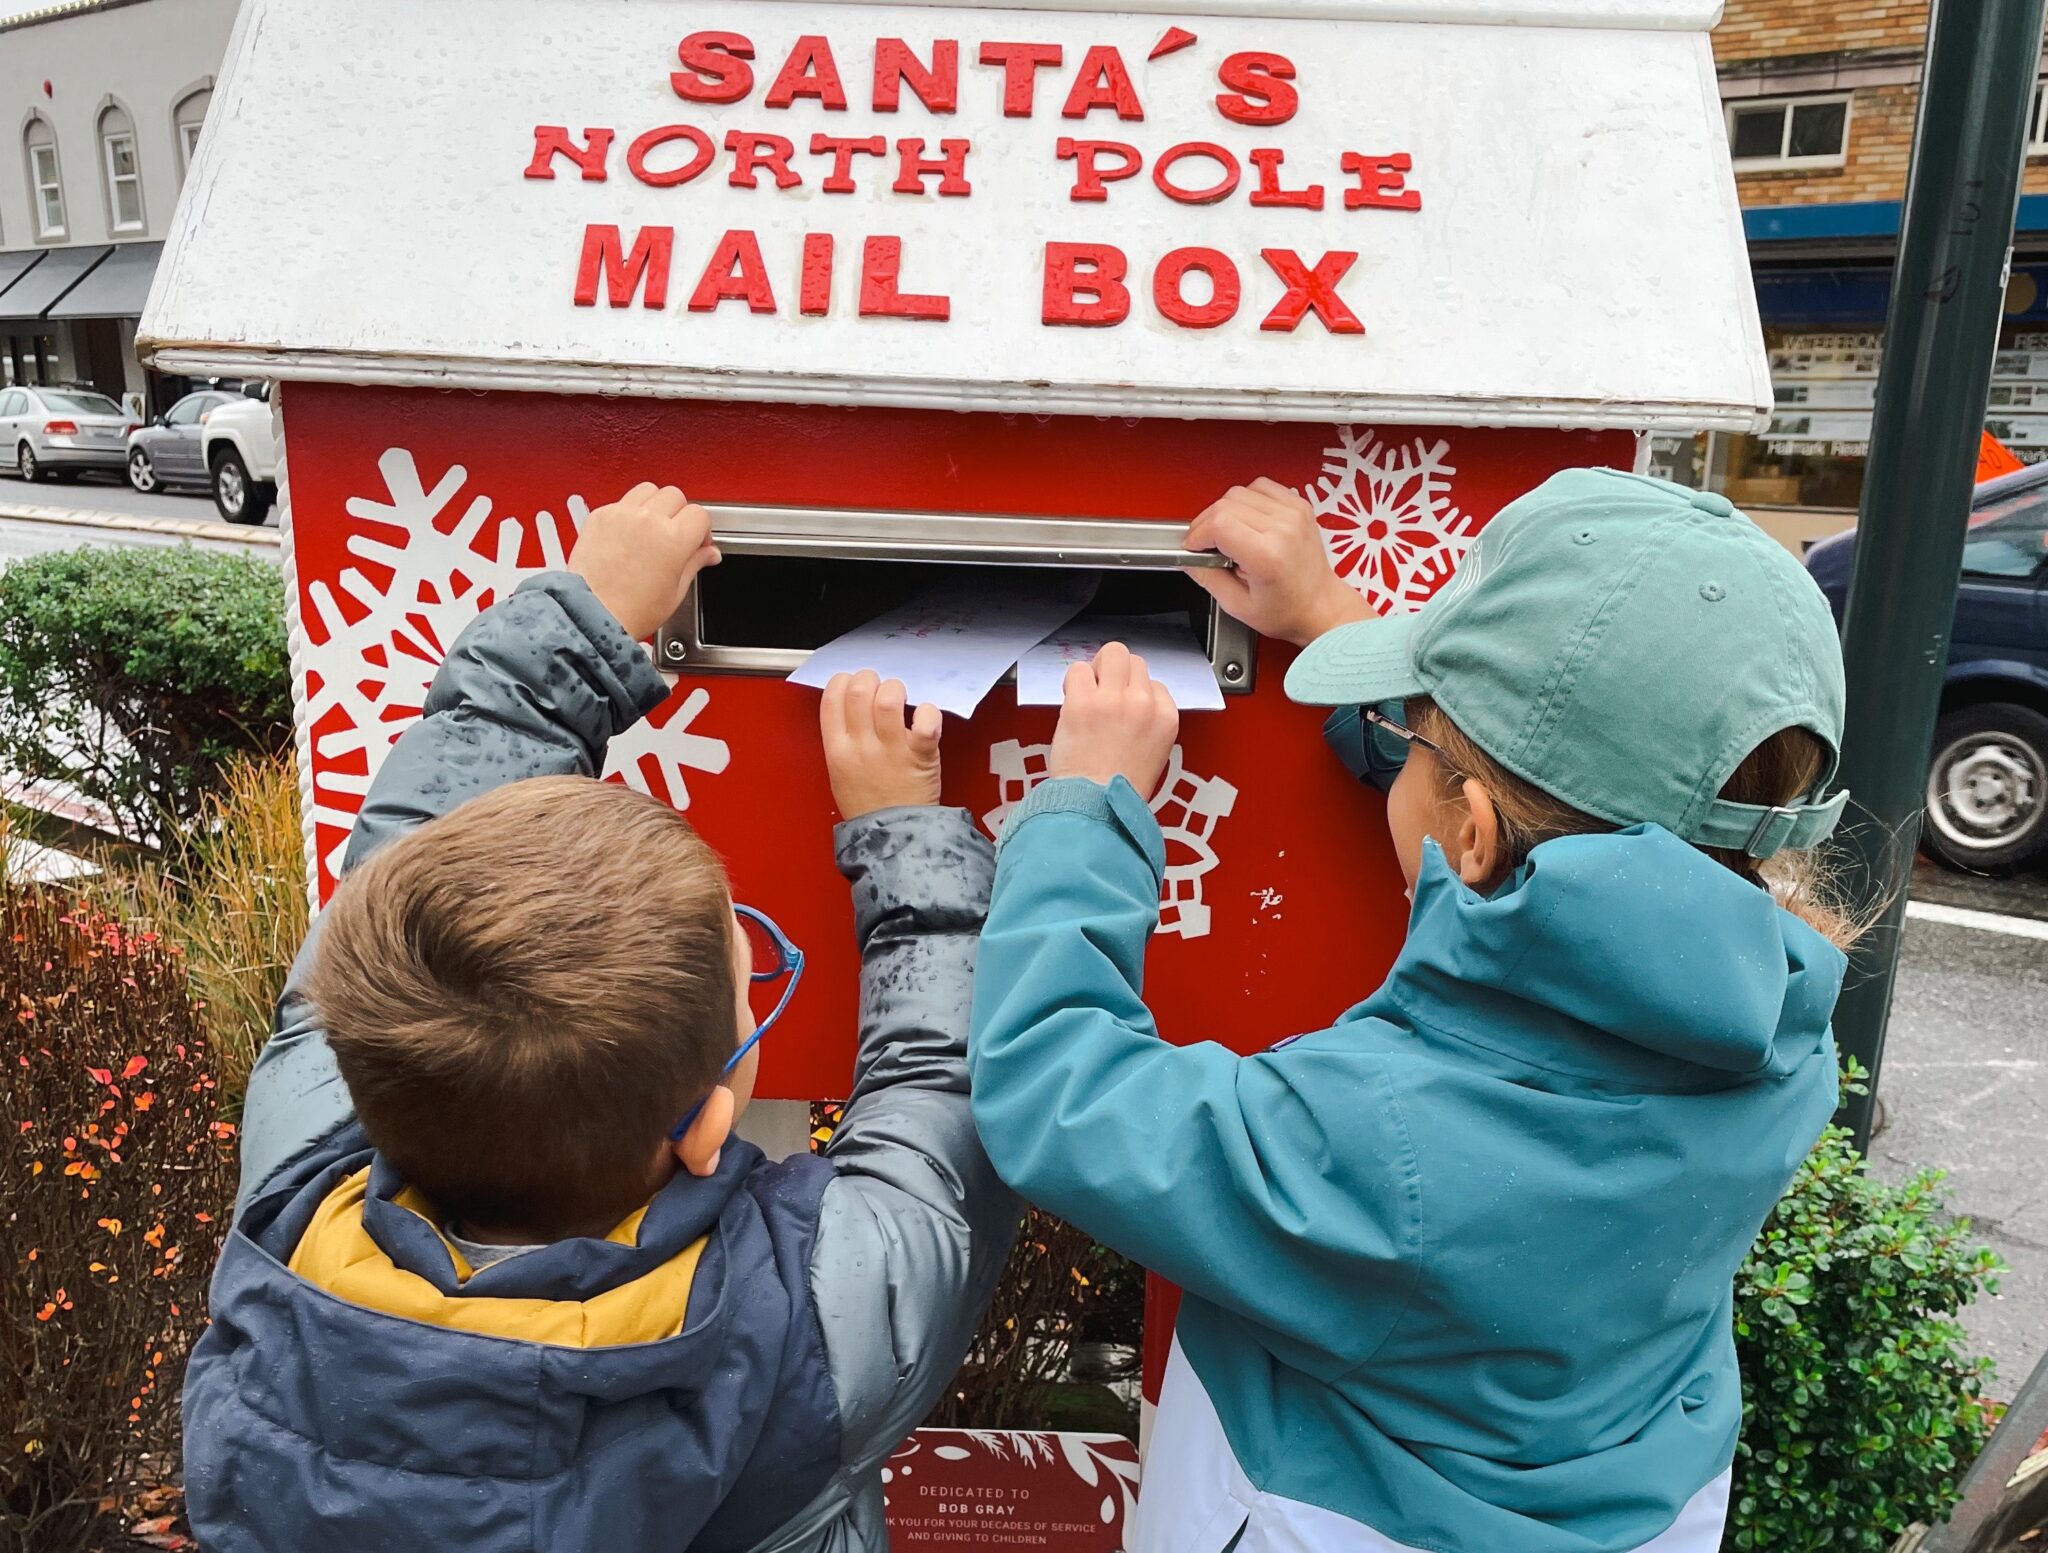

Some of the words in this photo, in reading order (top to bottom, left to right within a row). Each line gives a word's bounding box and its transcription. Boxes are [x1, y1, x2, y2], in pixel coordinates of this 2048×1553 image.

[670, 26, 1299, 127] SANTA'S
[523, 124, 971, 197] NORTH
[1056, 137, 1422, 212] POLE
[573, 224, 950, 322] MAIL
[1041, 241, 1366, 335] BOX
[1783, 333, 1883, 350] WATERFRON
[1830, 440, 1869, 457] Realt
[920, 1485, 1004, 1499] DEDICATED
[1011, 1488, 1031, 1500] TO
[938, 1503, 969, 1514] BOB
[975, 1504, 1015, 1516] GRAY
[899, 1518, 921, 1527] YOU
[924, 1518, 945, 1528] FOR
[949, 1519, 978, 1529] YOUR
[981, 1520, 1031, 1531] DECADES
[1034, 1522, 1047, 1531] OF
[1051, 1522, 1096, 1533] SERVICE
[907, 1531, 930, 1541] AND
[933, 1532, 971, 1542] GIVING
[975, 1533, 989, 1543] TO
[992, 1534, 1047, 1545] CHILDREN
